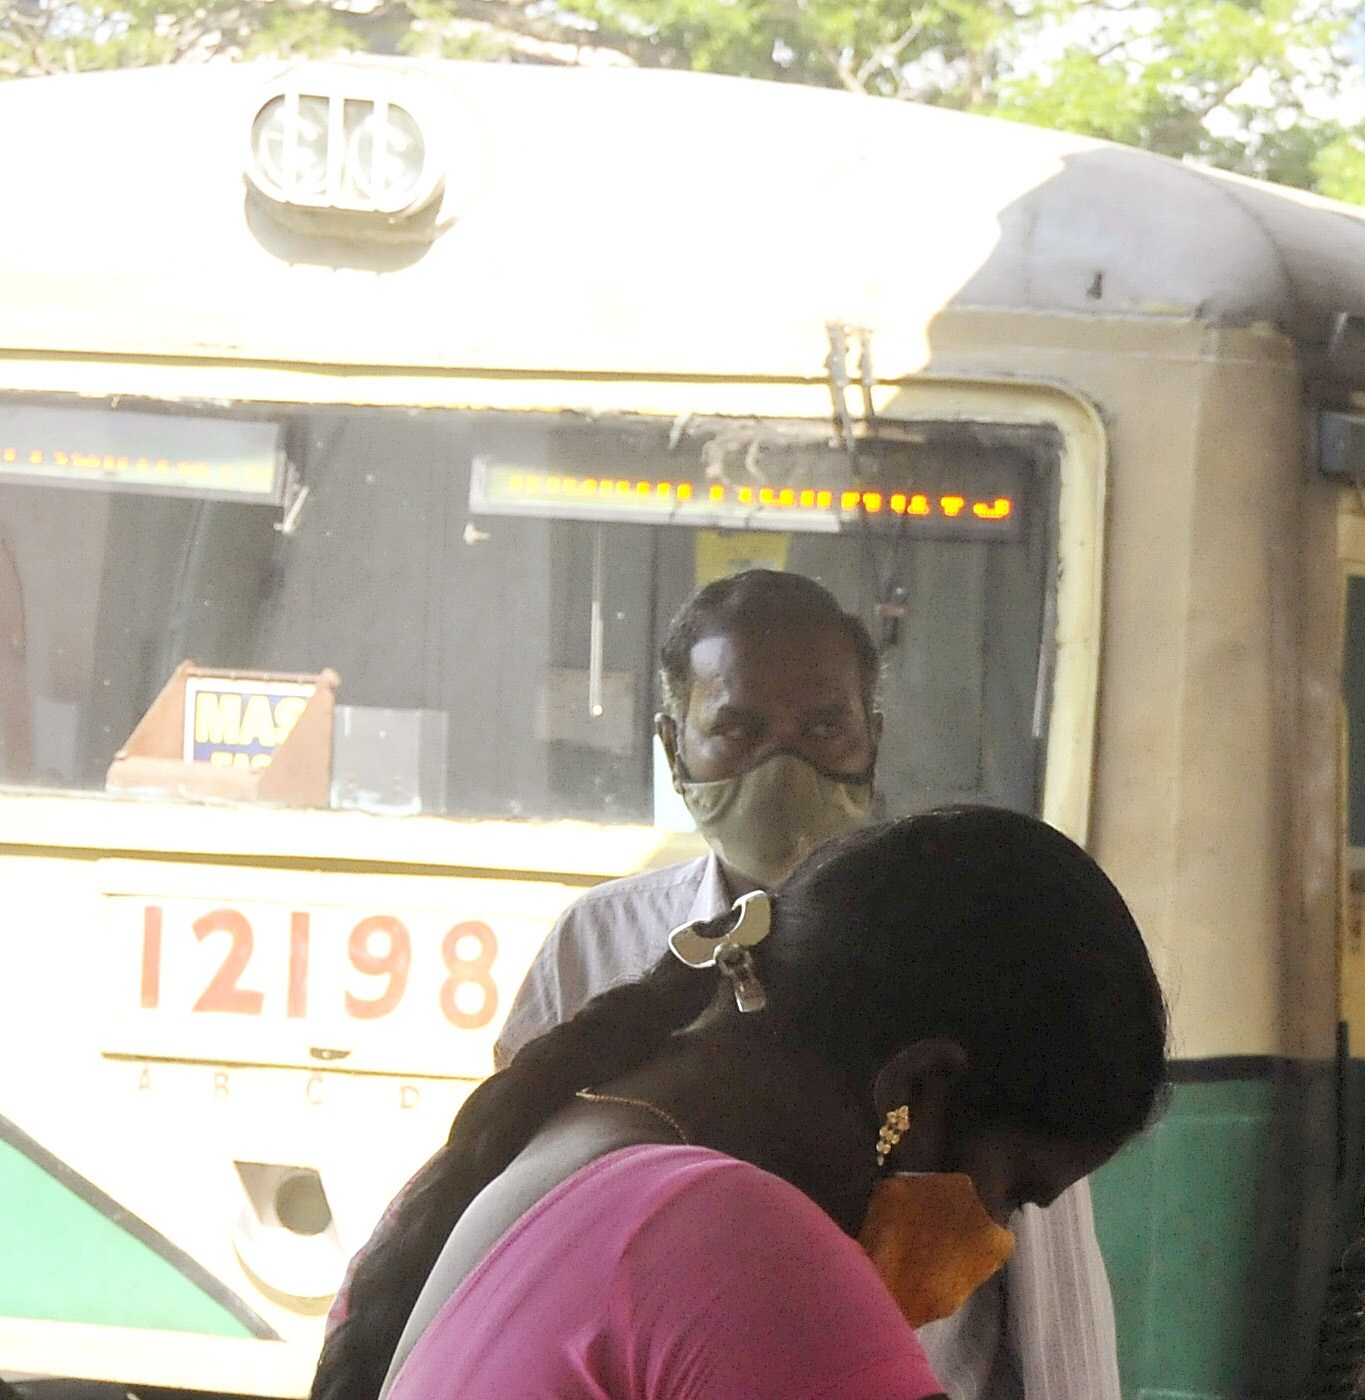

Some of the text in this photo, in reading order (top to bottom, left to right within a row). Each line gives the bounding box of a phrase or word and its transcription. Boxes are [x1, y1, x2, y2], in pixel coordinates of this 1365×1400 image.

[140, 905, 499, 1030] 12198
[306, 1074, 324, 1105] C
[400, 1085, 420, 1110] D
